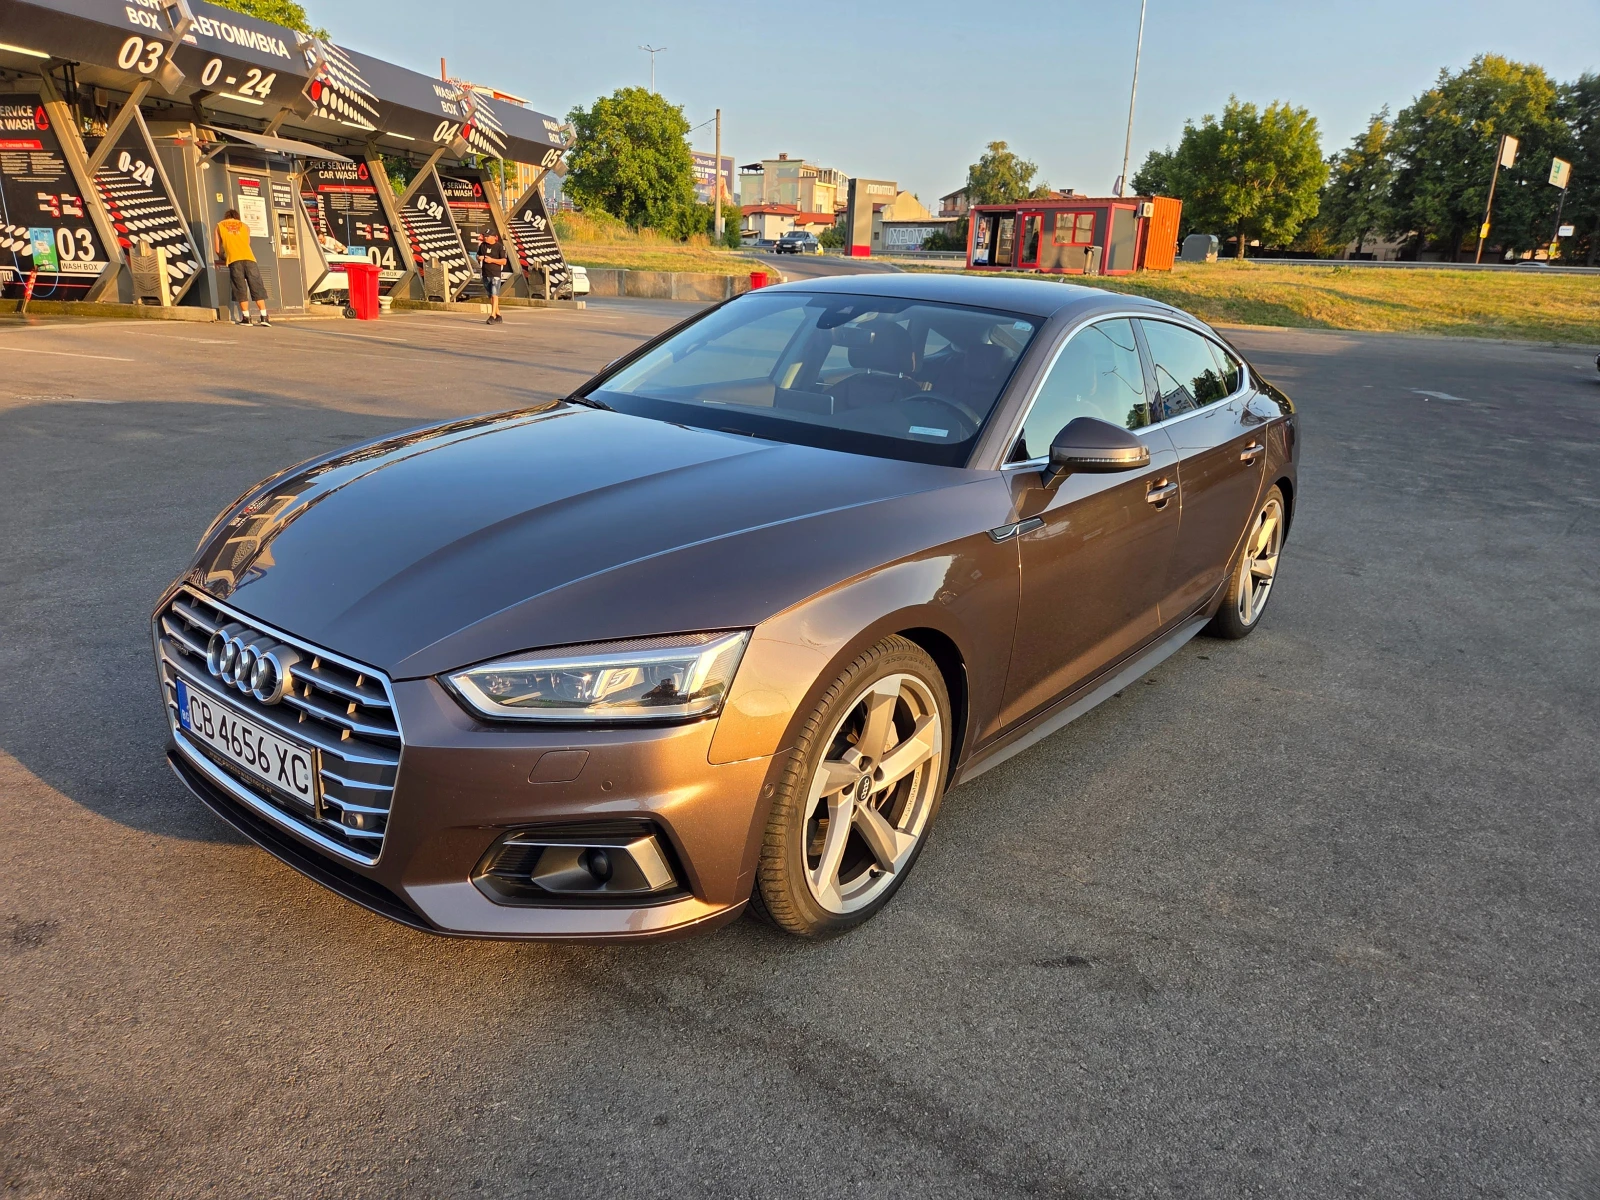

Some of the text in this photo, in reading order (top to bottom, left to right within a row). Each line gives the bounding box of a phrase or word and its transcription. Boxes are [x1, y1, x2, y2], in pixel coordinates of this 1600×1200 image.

[126, 6, 163, 32] BOX
[189, 15, 292, 60] АВТОМИВКА
[117, 36, 165, 74] 03
[201, 58, 223, 86] 0
[238, 68, 277, 99] 24
[432, 84, 457, 102] WASH
[0, 105, 33, 117] ERVICE
[440, 100, 459, 116] BOX
[4, 118, 36, 130] WASH
[432, 120, 460, 145] 04
[542, 118, 560, 133] WASH
[547, 132, 562, 145] BOX
[327, 161, 357, 171] SERVICE
[540, 148, 562, 168] 05
[118, 151, 155, 187] 0-24
[318, 170, 358, 180] CAR WASH
[443, 189, 473, 197] AR WASH
[417, 195, 444, 220] 0-24
[523, 209, 546, 231] 0-24
[57, 227, 95, 261] 03
[61, 262, 98, 271] WASH BOX
[367, 246, 397, 270] 04
[190, 695, 215, 740] CB
[218, 714, 271, 774] 4656
[274, 743, 309, 796] XC
